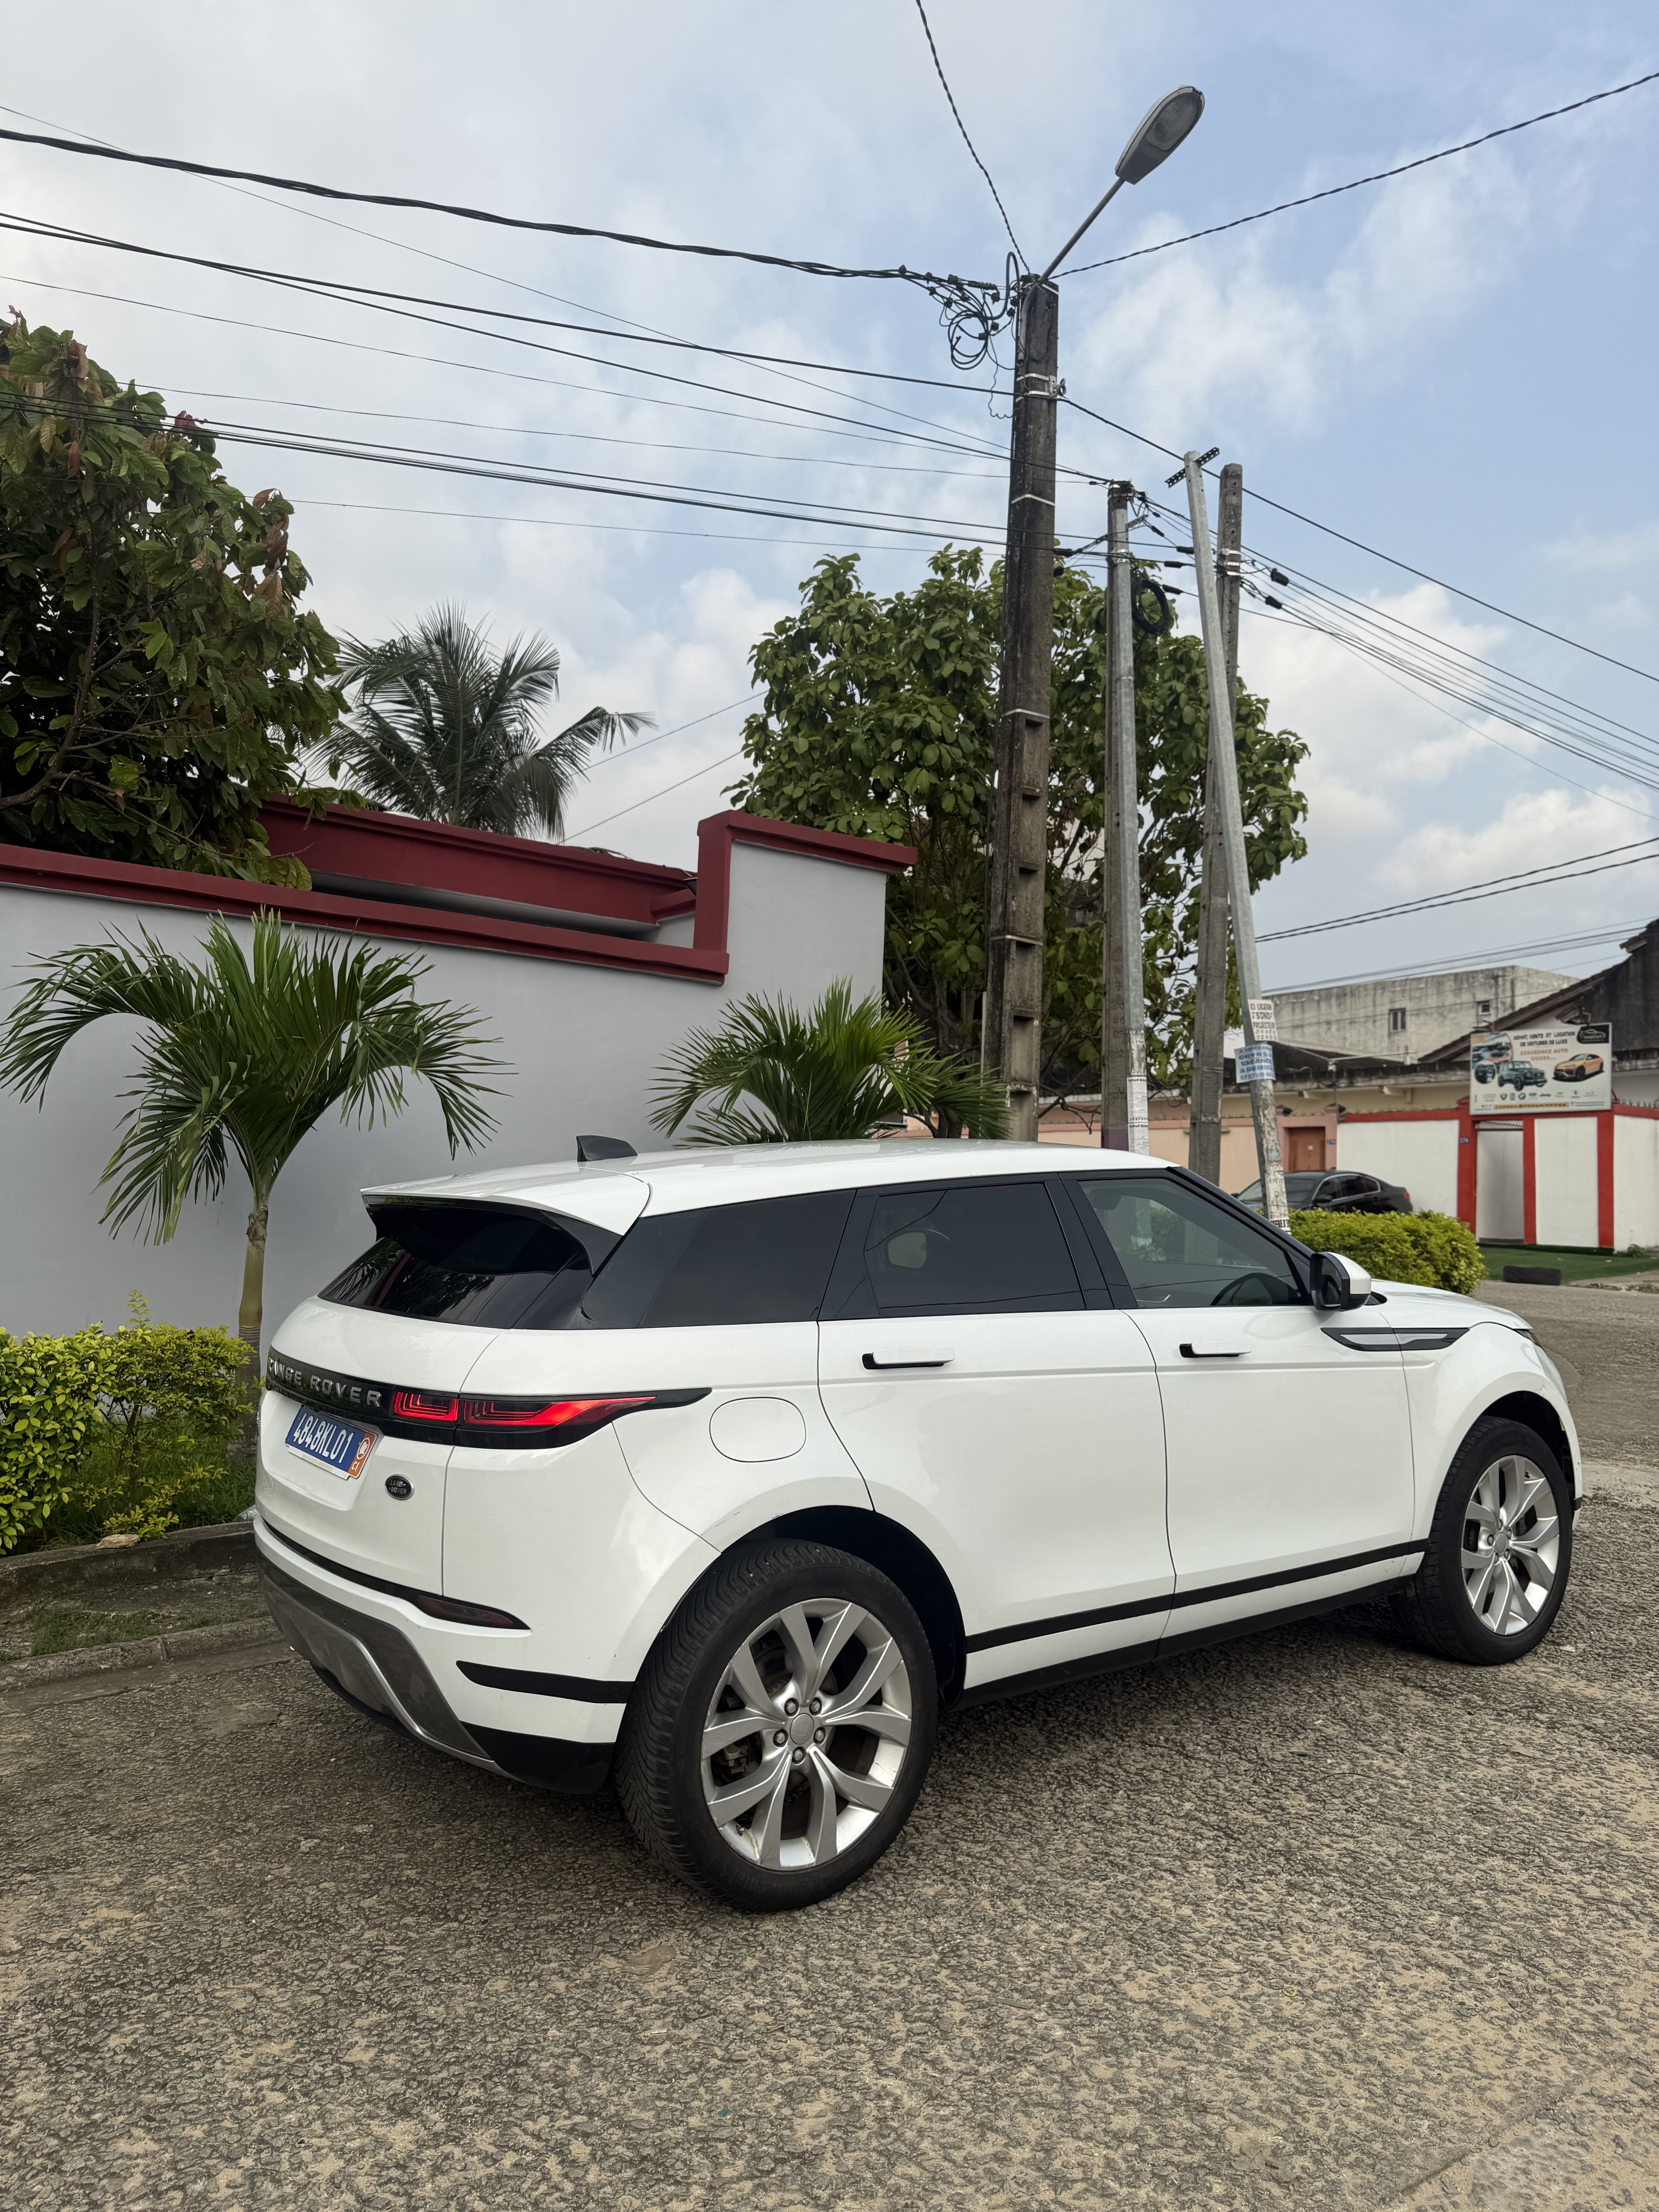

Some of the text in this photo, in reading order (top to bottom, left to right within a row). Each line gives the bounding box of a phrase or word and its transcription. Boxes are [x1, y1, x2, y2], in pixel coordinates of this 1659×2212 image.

[268, 1357, 383, 1407] RANGE ROVER
[293, 1412, 354, 1464] 4848KL01
[351, 1461, 360, 1472] CI
[391, 1486, 407, 1494] ROVER
